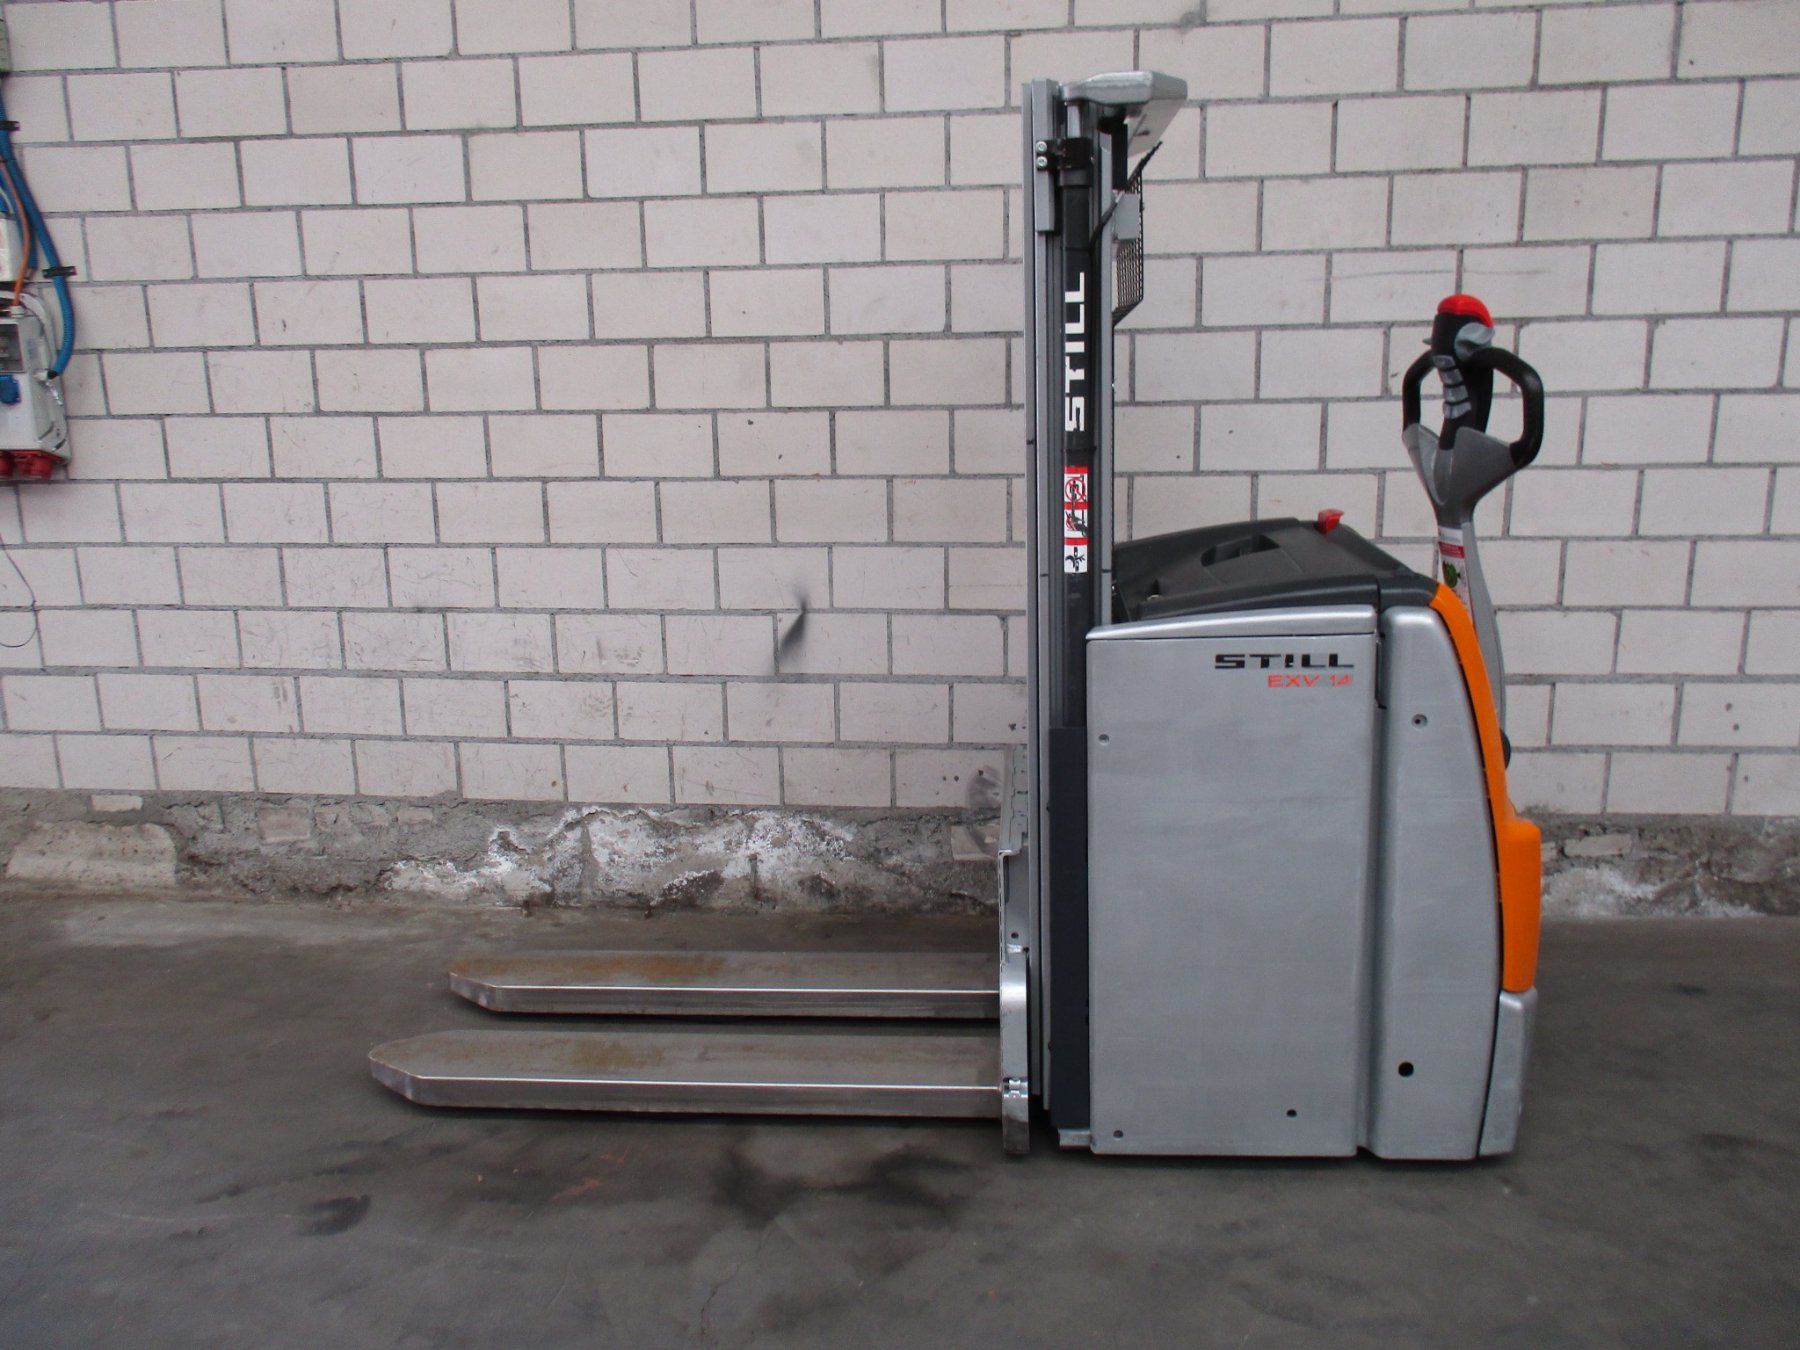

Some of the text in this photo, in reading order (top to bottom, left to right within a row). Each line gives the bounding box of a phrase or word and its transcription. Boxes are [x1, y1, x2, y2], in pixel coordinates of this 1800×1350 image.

[1065, 272, 1085, 431] STILL
[1215, 653, 1354, 668] STILL
[1268, 674, 1352, 688] EXV 14
